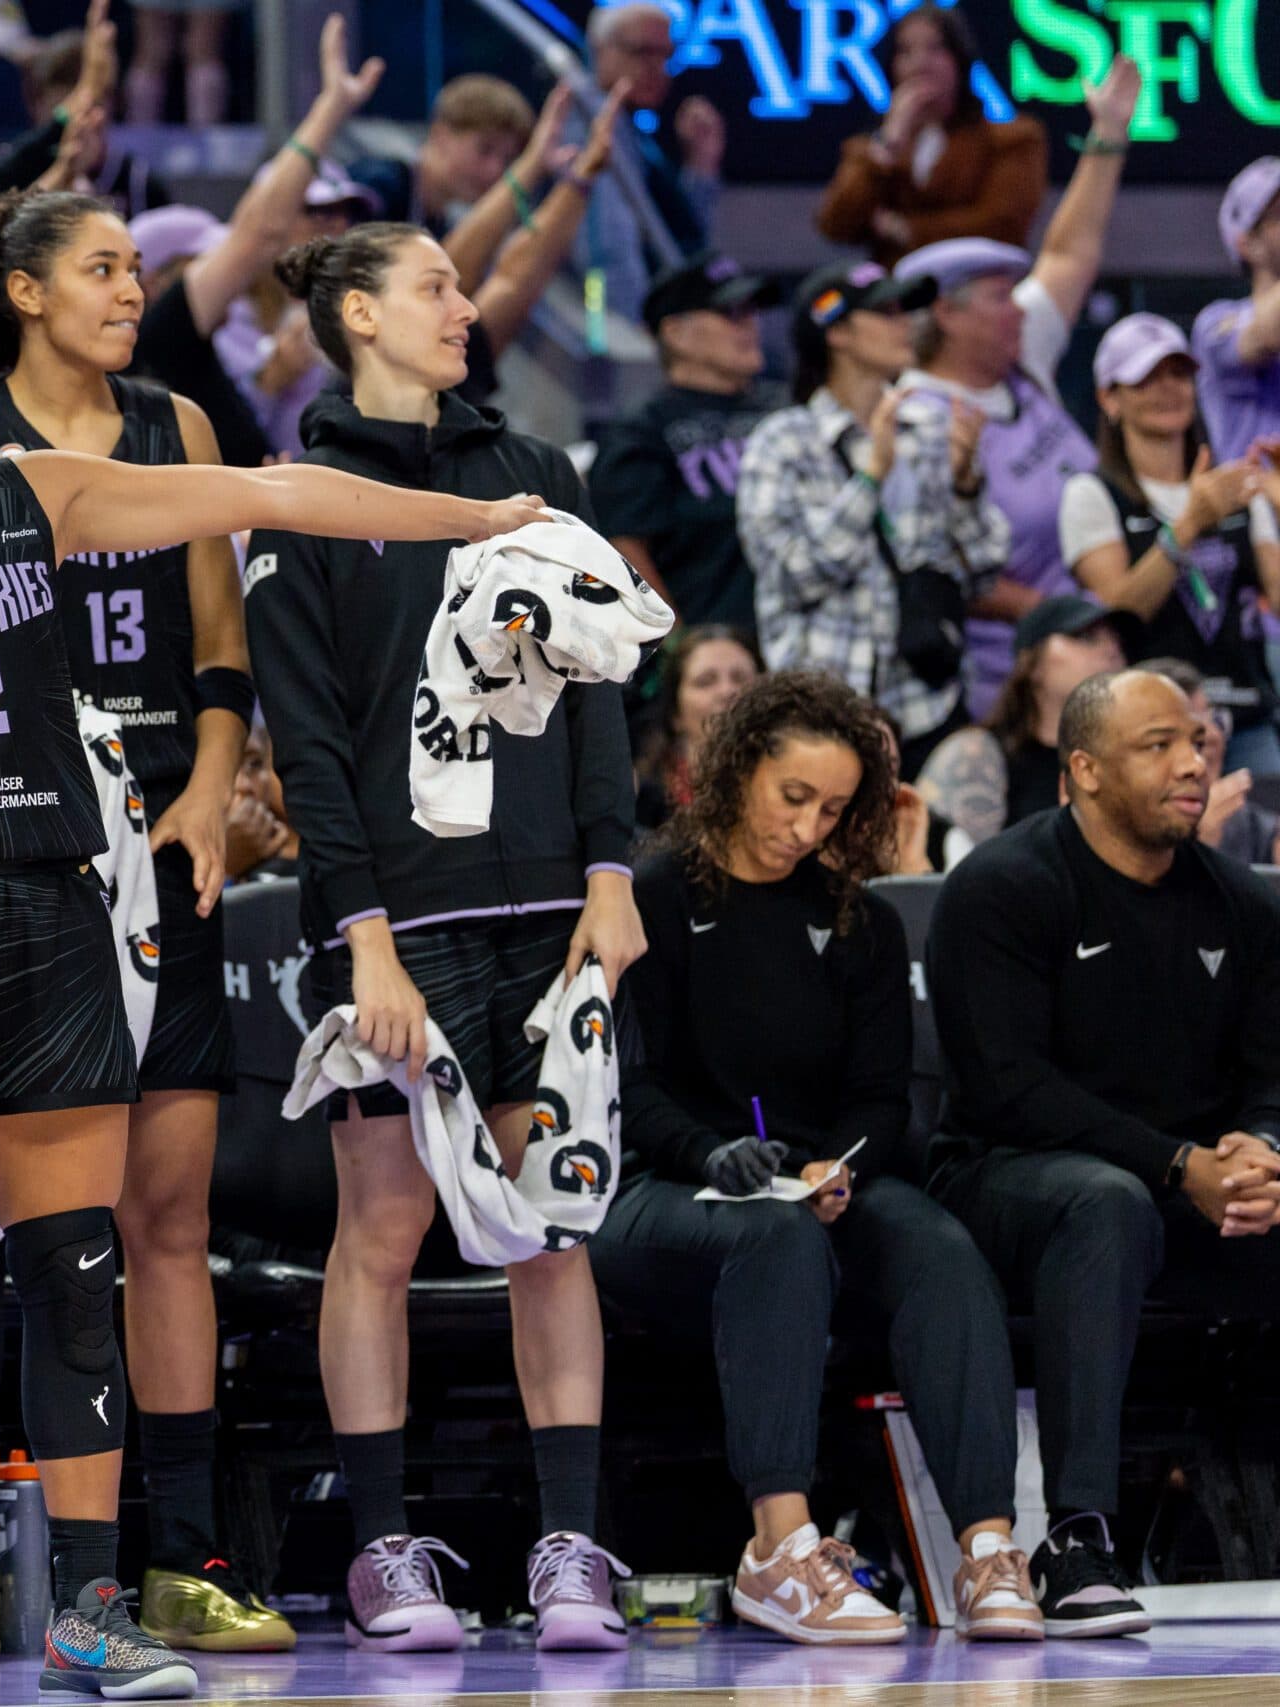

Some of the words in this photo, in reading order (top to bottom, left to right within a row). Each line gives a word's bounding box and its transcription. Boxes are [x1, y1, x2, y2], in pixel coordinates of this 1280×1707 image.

[1, 528, 38, 543] freedom
[85, 589, 147, 664] 13
[103, 696, 143, 710] KAISER
[120, 711, 178, 727] RMANENTE
